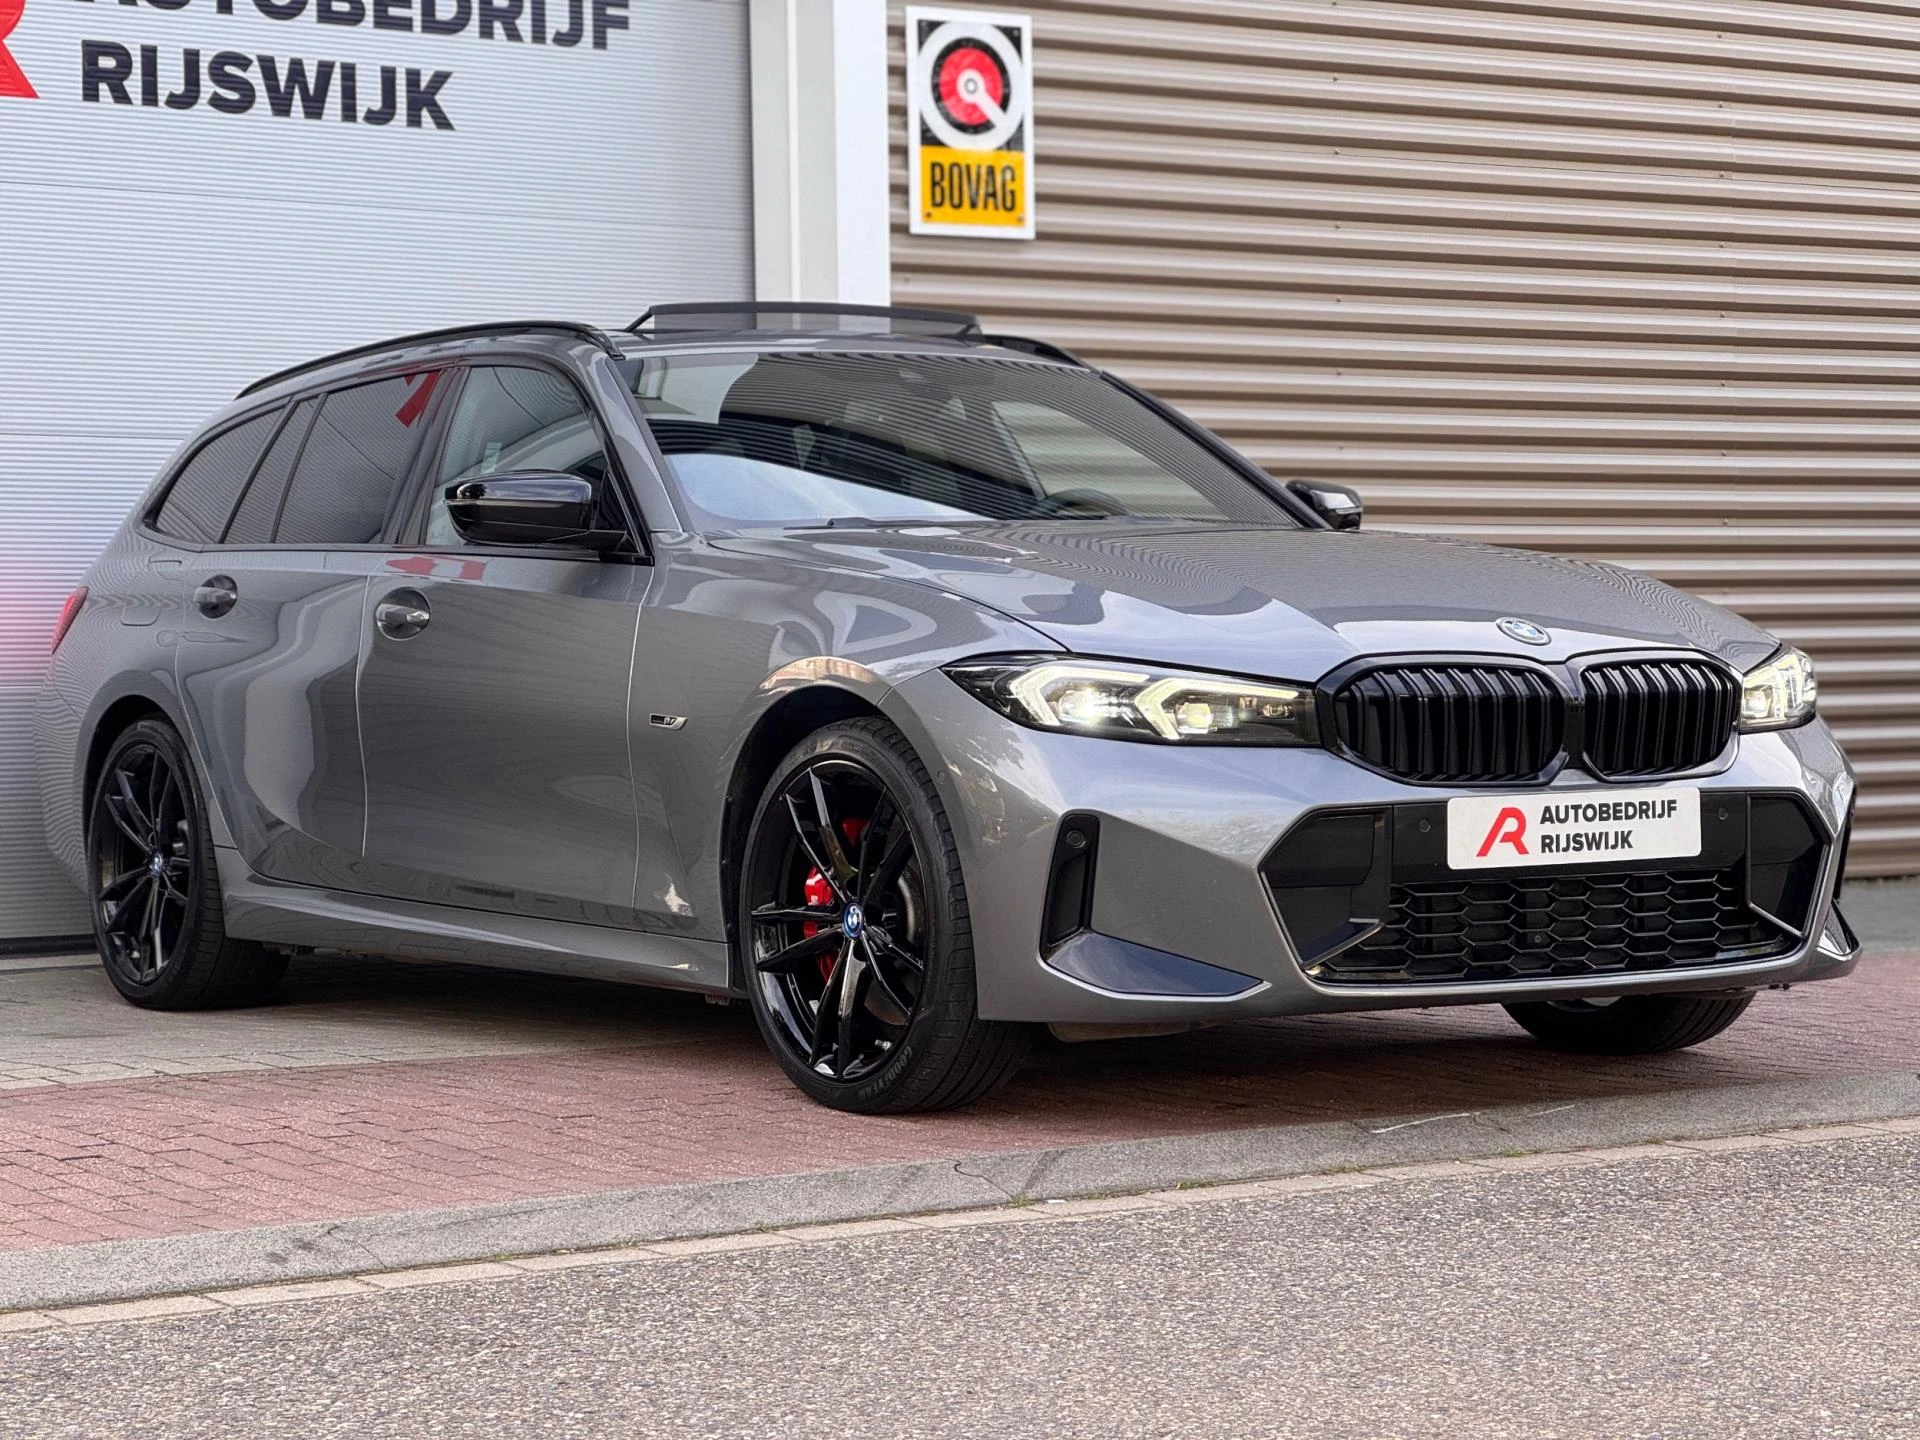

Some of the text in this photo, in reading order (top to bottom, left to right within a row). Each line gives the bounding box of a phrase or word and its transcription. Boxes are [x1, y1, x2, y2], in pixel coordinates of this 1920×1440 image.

[81, 39, 455, 131] RIJSWIJK
[930, 161, 1017, 212] BOVAG
[1540, 799, 1678, 825] AUTOBEDRIJF
[1540, 830, 1633, 854] RIJSWIJK
